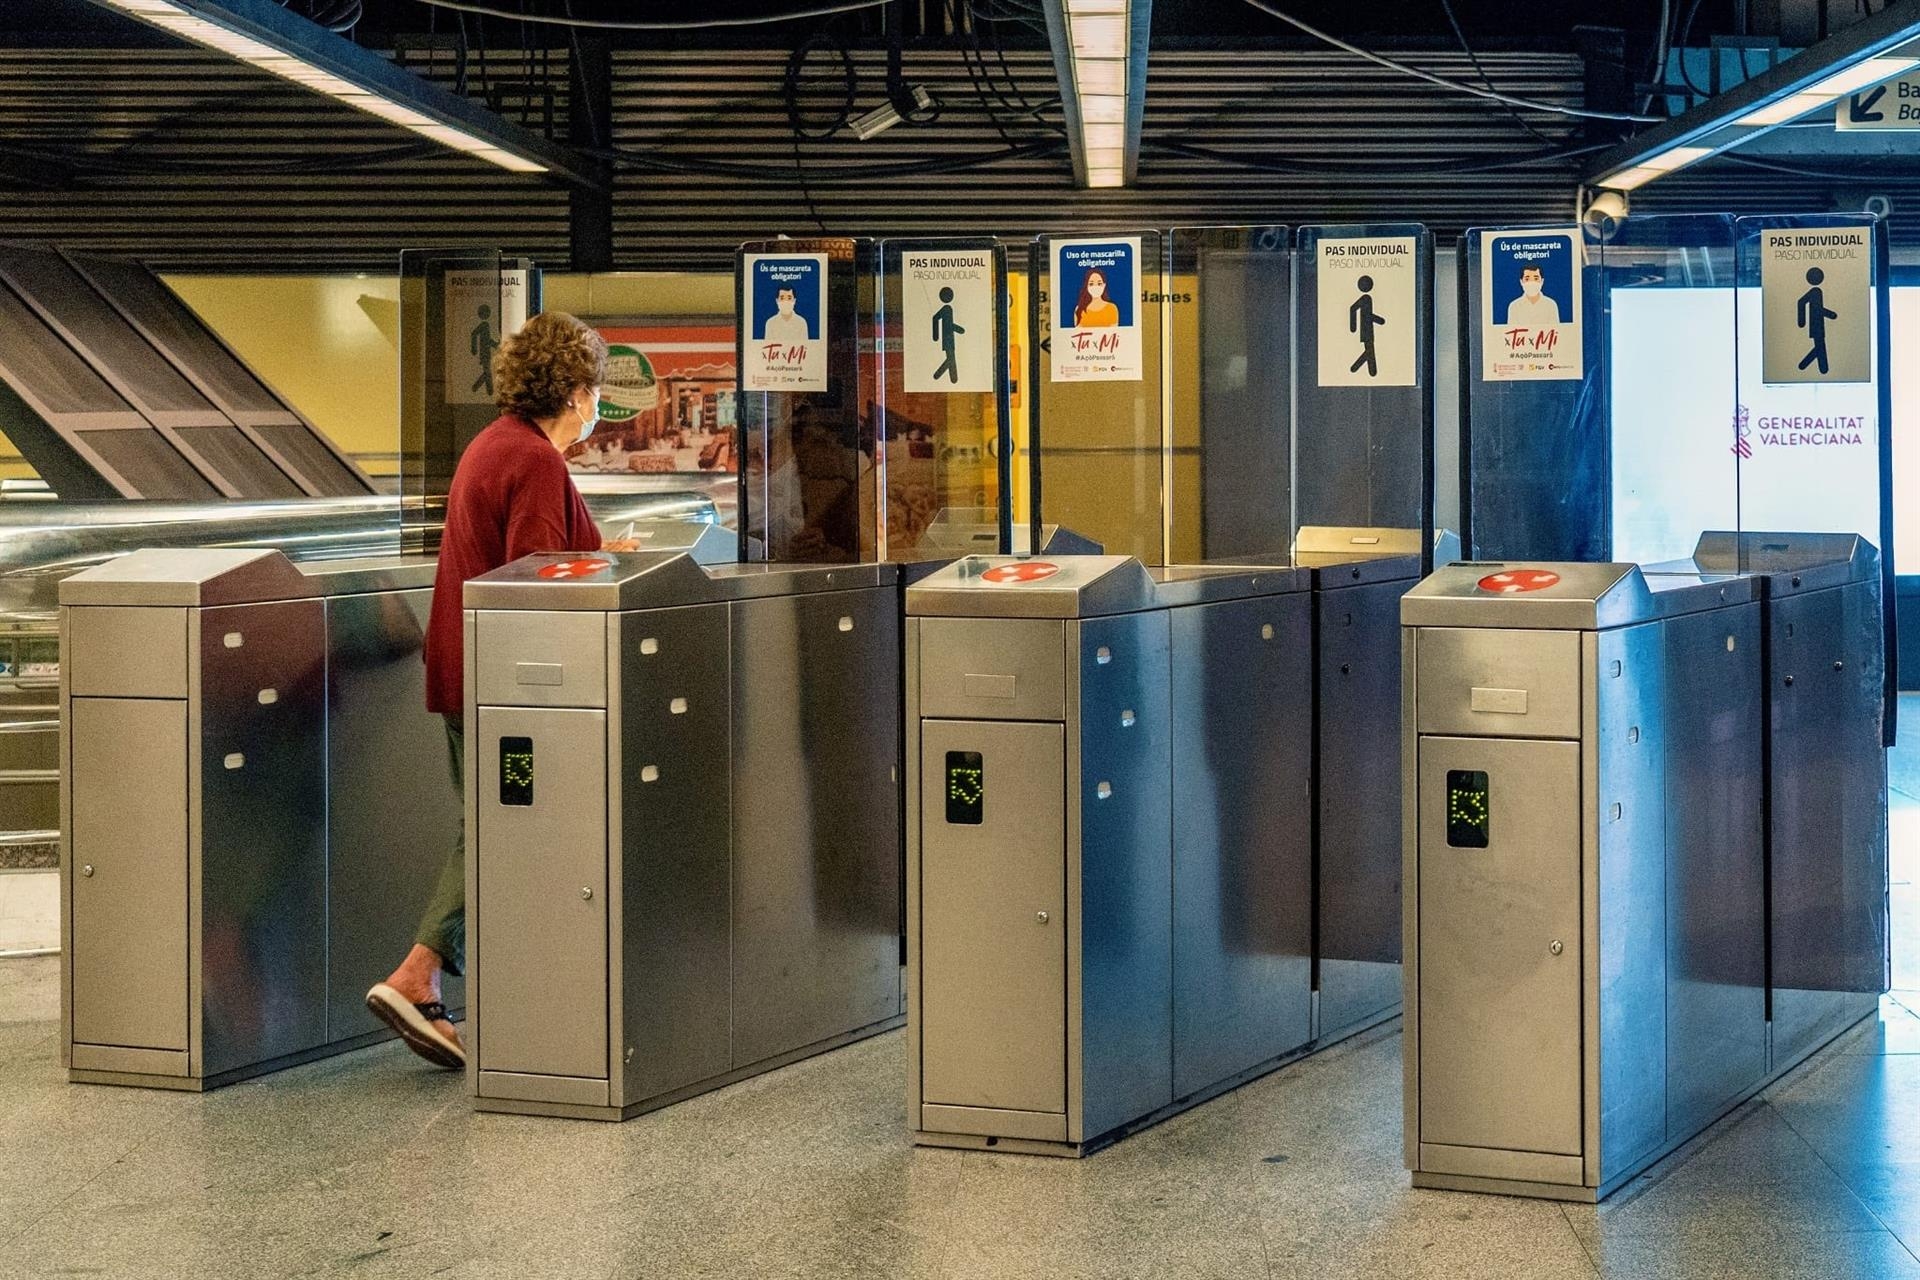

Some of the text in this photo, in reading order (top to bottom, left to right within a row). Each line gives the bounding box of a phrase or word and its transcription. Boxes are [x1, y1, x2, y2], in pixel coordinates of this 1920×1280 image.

[1501, 241, 1561, 251] Ús de mascareta
[1770, 235, 1863, 247] PAS INDIVIDUAL
[1080, 250, 1089, 258] de
[1090, 250, 1126, 258] mascarilla
[1325, 245, 1408, 256] PAS INDIVIDUAL
[1514, 250, 1550, 260] obligatori
[1775, 249, 1856, 260] PASO INDIVIDUAL
[760, 263, 812, 272] Ús de mascareta
[910, 257, 985, 268] PAS INDIVIDUAL
[1078, 258, 1115, 268] obligatorio
[1329, 258, 1404, 269] PASO INDIVIDUAL
[771, 272, 802, 282] obligatori
[913, 270, 980, 280] PASO INDIVIDUAL
[1758, 416, 1864, 430] GENERALITAT
[1761, 433, 1862, 446] VALENCIANA
